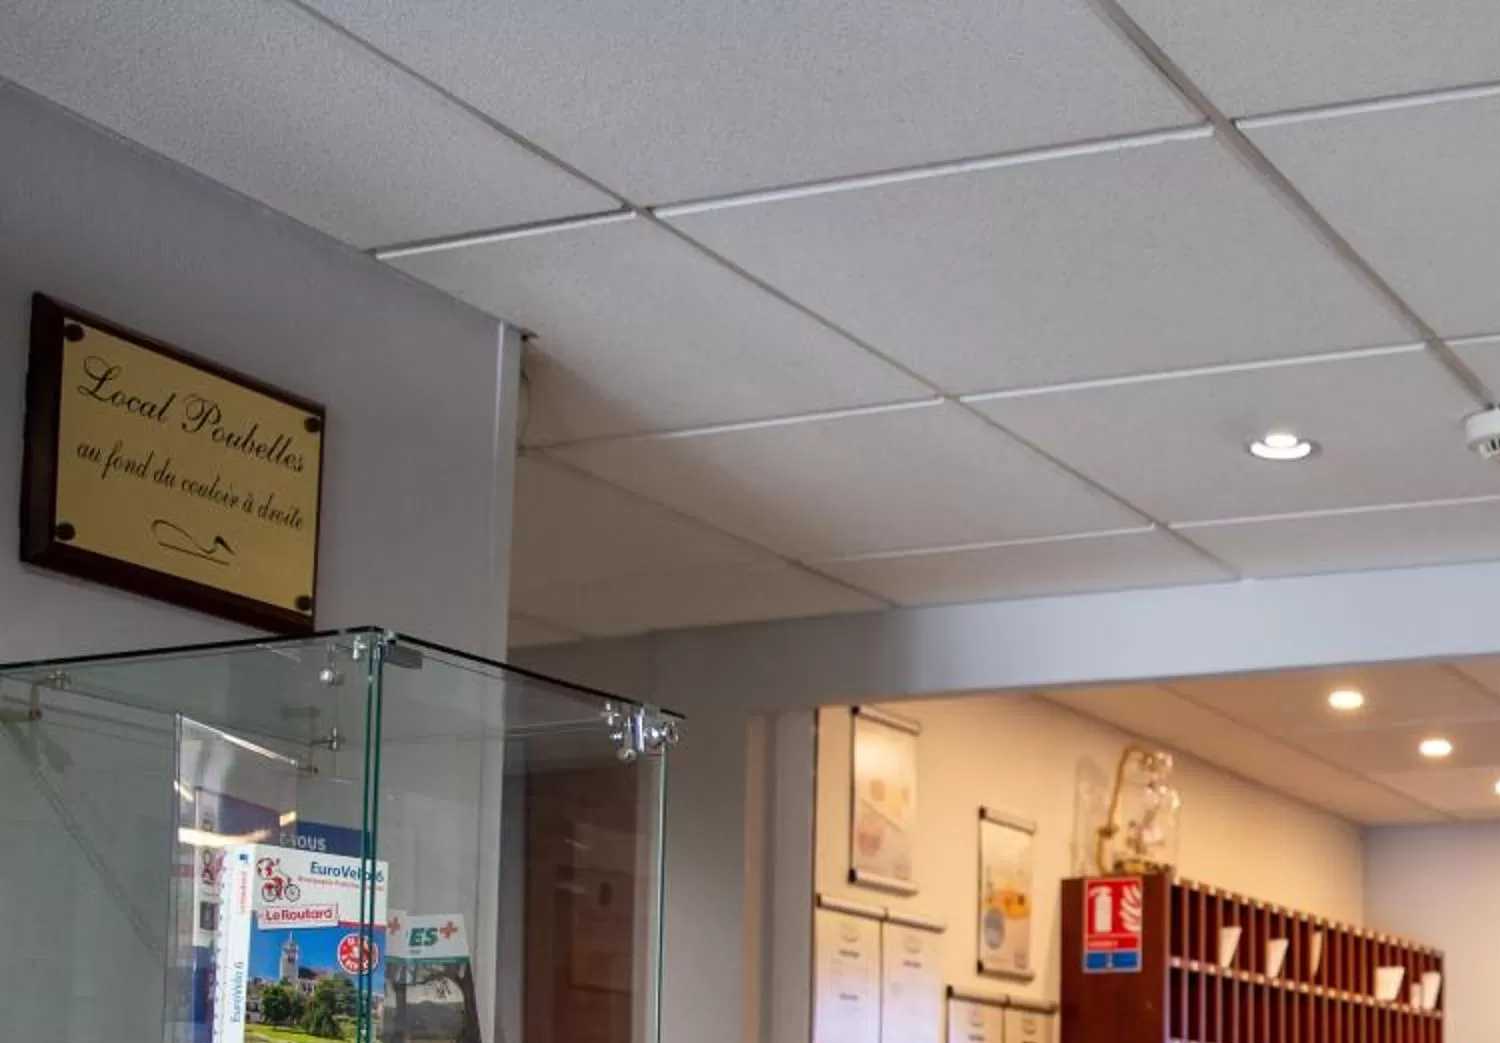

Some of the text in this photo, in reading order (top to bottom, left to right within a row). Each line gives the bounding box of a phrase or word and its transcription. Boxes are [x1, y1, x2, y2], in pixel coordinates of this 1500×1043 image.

[76, 355, 304, 472] Local Poubelles
[77, 440, 303, 529] au fond du couloir à droite
